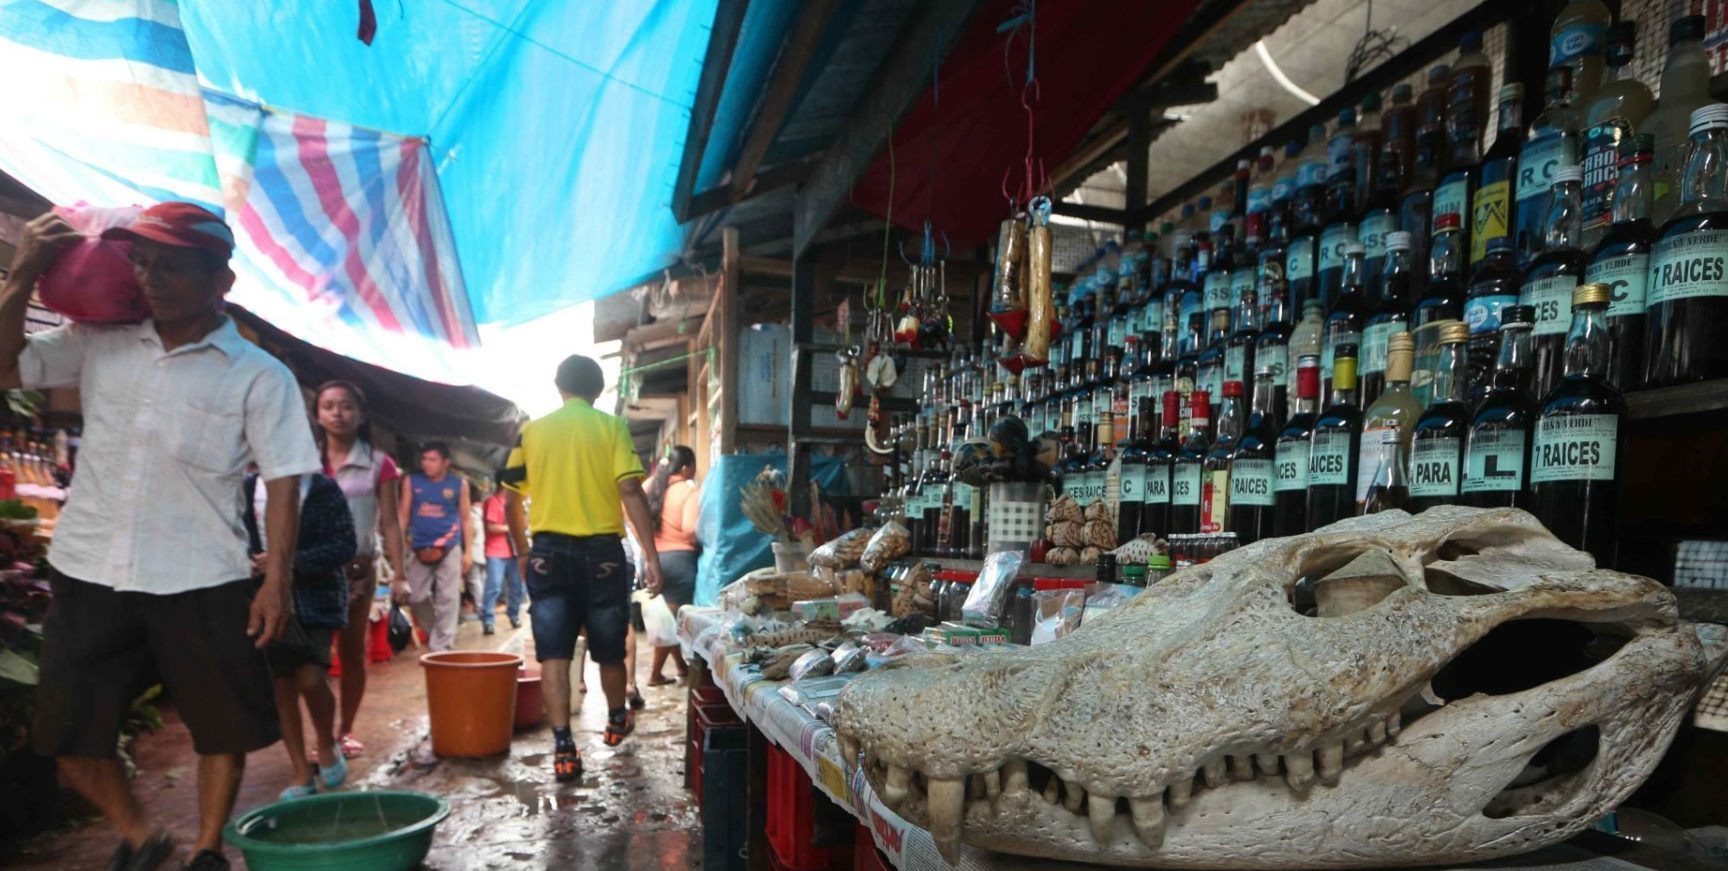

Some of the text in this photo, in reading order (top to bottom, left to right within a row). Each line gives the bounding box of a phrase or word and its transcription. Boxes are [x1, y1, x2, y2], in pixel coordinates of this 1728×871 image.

[1521, 168, 1534, 186] R
[1580, 167, 1619, 190] ANC
[1653, 267, 1660, 291] 7
[1662, 257, 1724, 288] RAICES
[1609, 280, 1630, 303] C
[1536, 446, 1541, 468] 7
[1543, 440, 1600, 467] RAICES
[1416, 462, 1451, 484] PARA
[1484, 454, 1516, 477] L
[1124, 480, 1132, 493] C
[1147, 481, 1165, 496] PARA
[1235, 478, 1268, 494] RAICES
[980, 634, 1006, 644] RUDA
